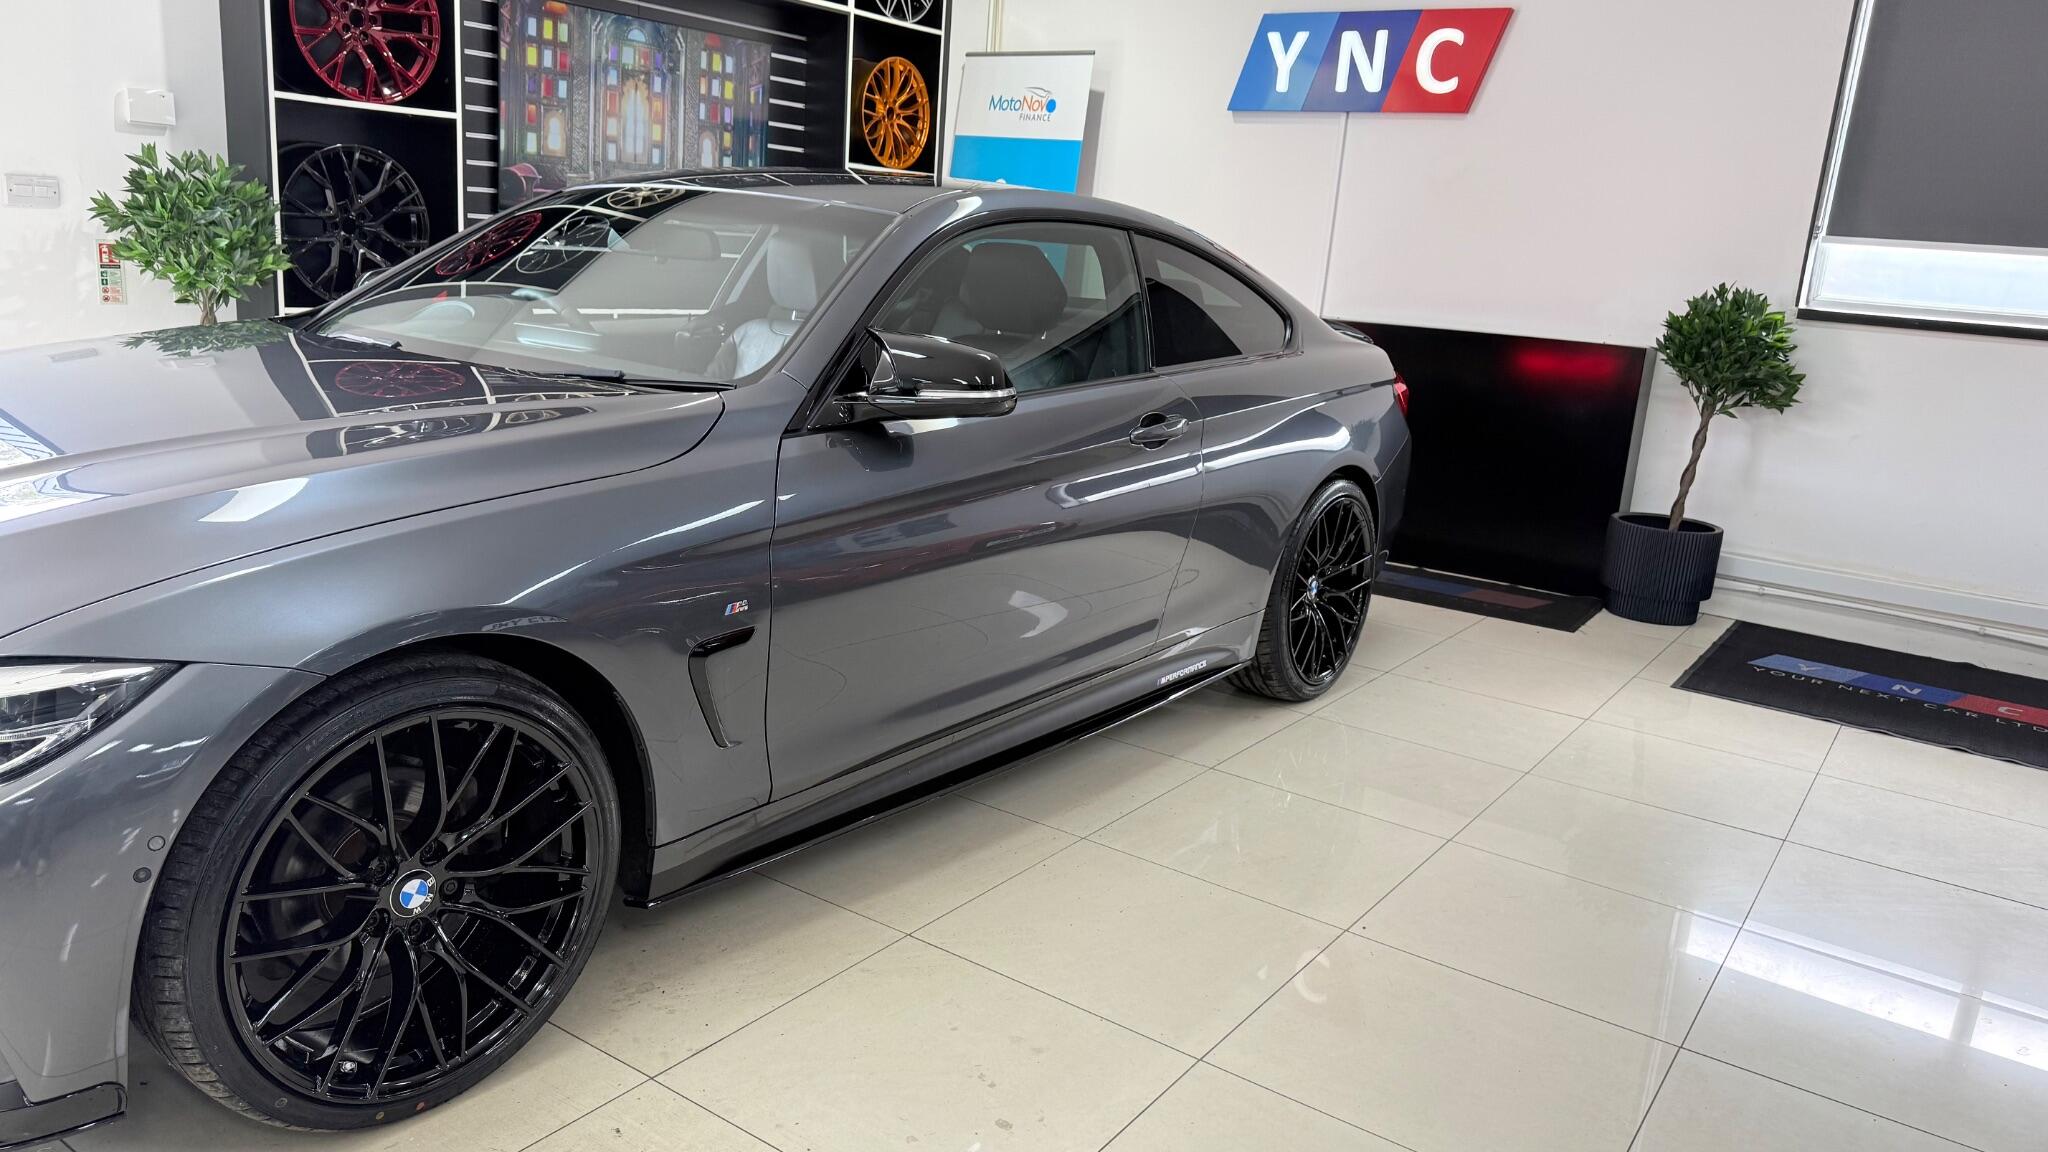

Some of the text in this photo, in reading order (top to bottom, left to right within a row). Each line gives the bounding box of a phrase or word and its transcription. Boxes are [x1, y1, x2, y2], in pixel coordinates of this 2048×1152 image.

[1267, 27, 1465, 95] YNC
[1018, 113, 1052, 122] FINANCE
[1753, 666, 2048, 732] YOUR NEXT CAR LTD
